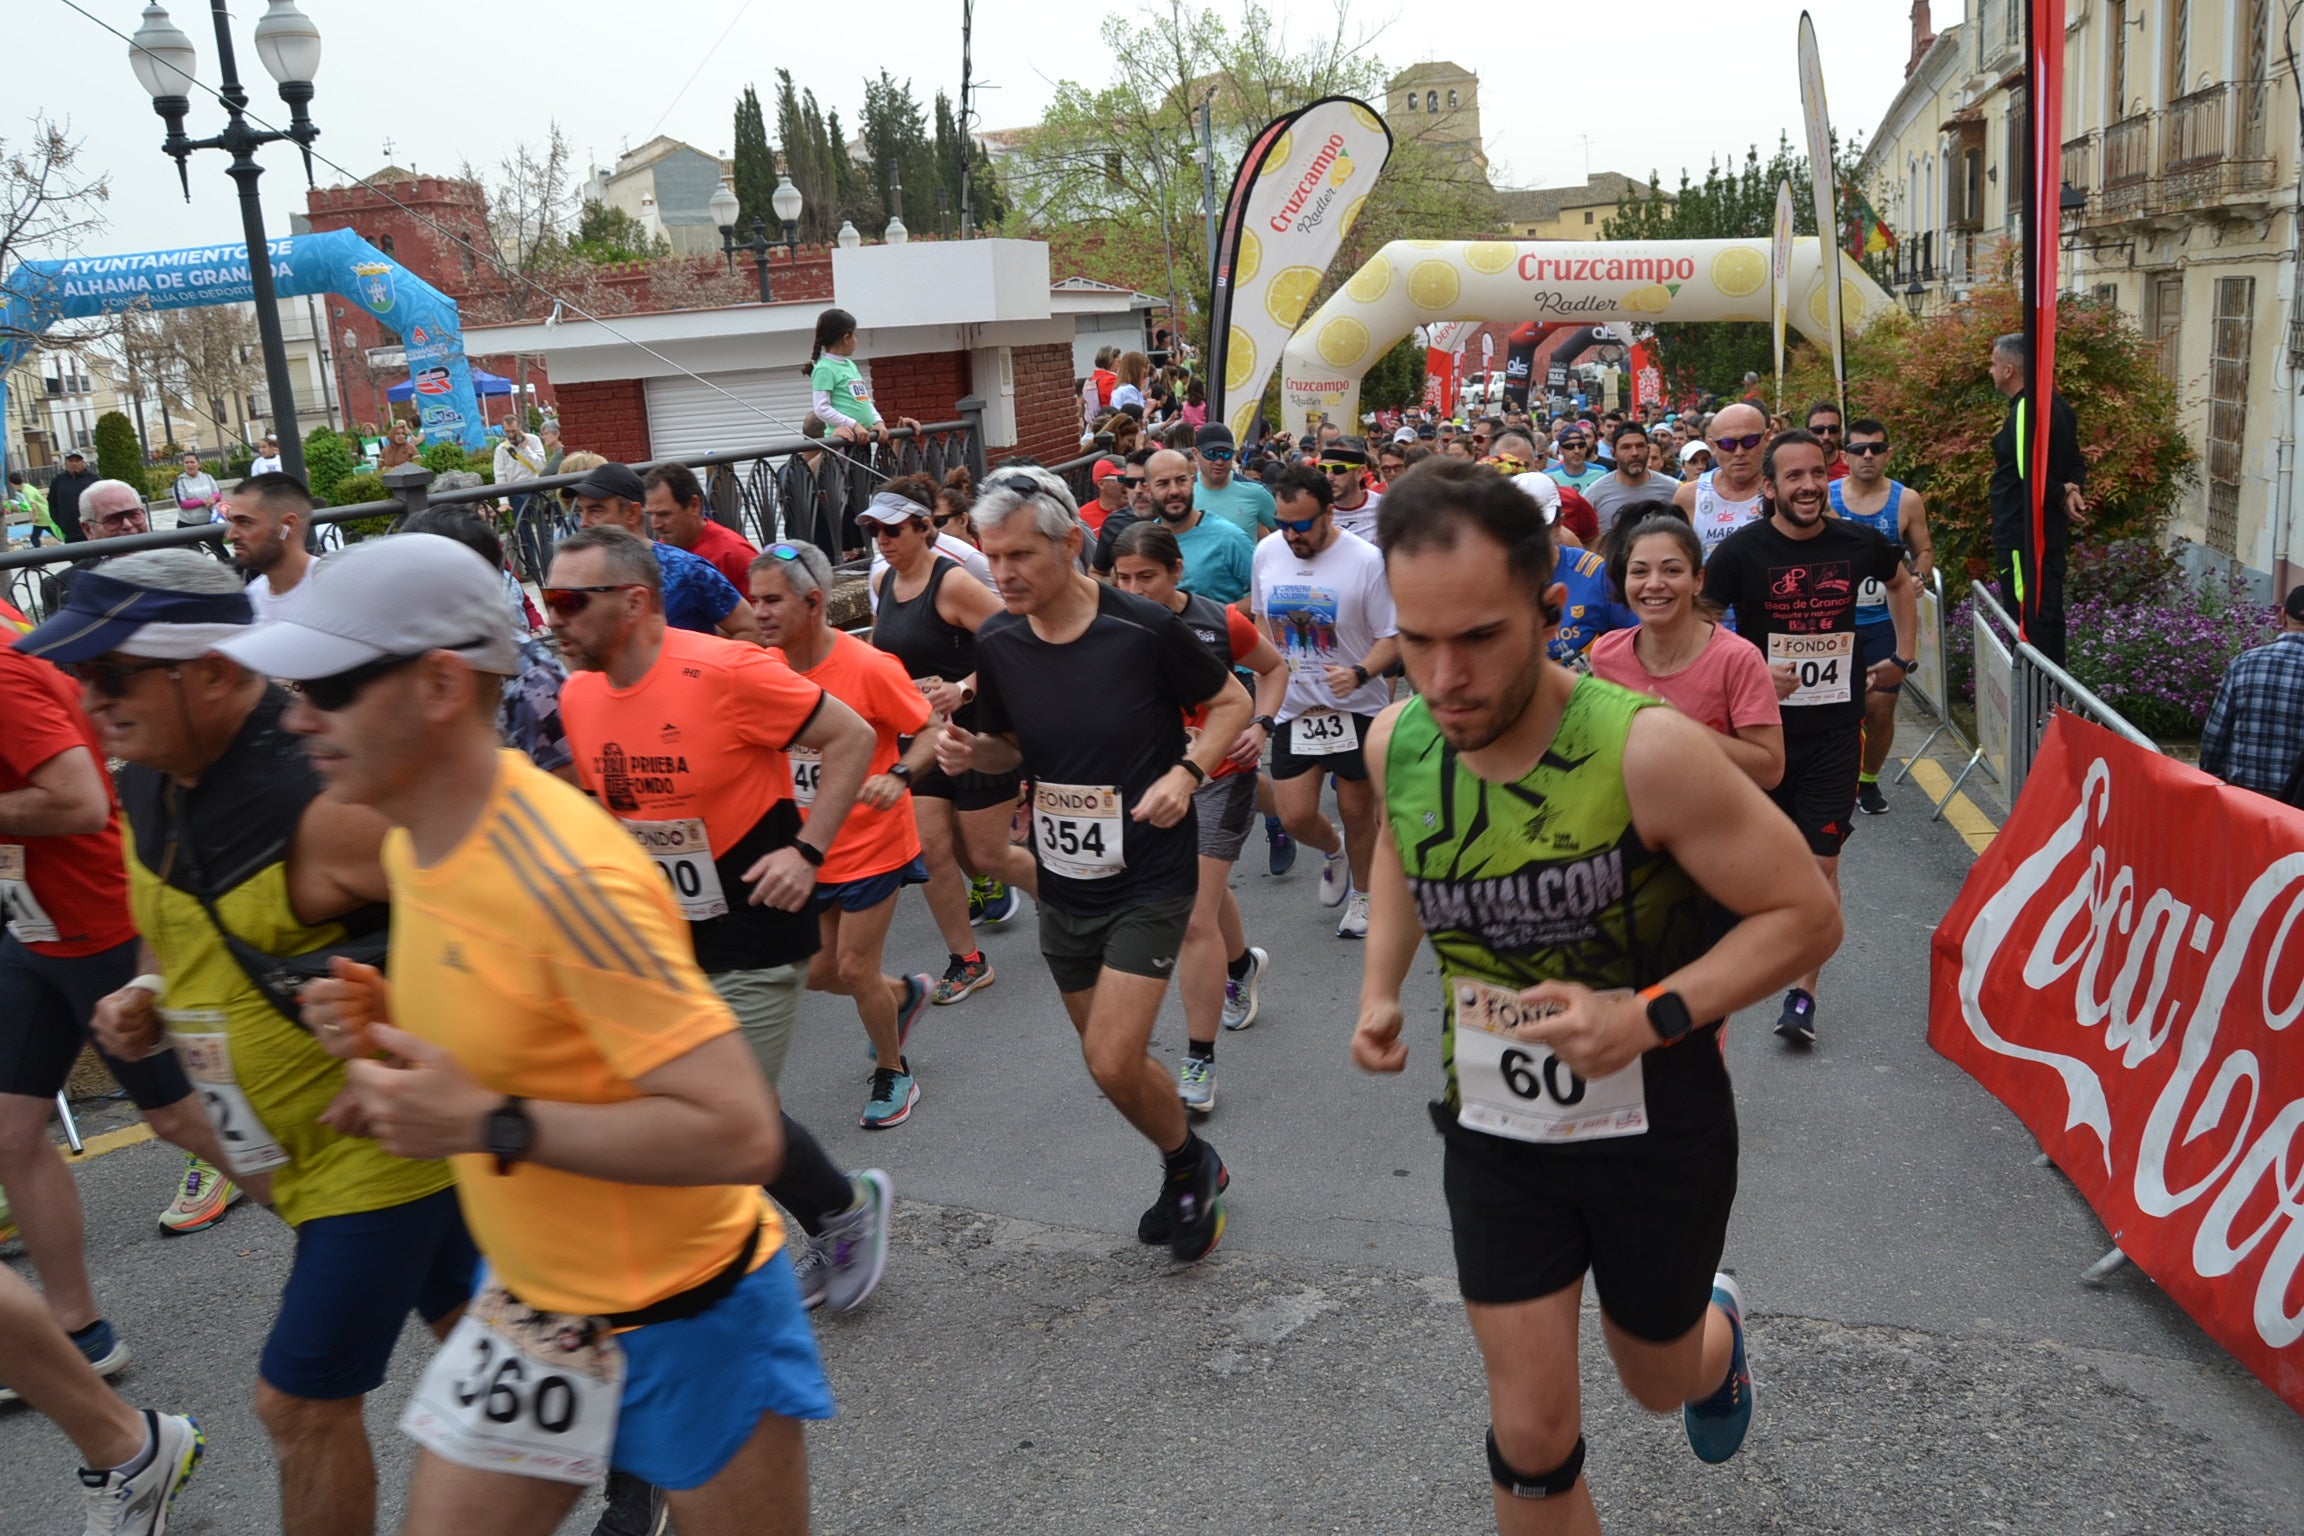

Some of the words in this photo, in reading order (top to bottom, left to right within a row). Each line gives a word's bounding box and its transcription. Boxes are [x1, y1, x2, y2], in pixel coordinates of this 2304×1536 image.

[1270, 133, 1345, 233] Cruzcampo
[1297, 188, 1336, 233] Radler
[61, 245, 250, 275] AYUNTAMIENTO
[266, 240, 294, 256] DE
[1518, 252, 1695, 285] Cruzcampo
[64, 275, 152, 298] ALHAMA
[155, 270, 186, 290] DE
[179, 289, 197, 301] DE
[199, 285, 255, 299] DEPORTE
[1534, 291, 1619, 315] Radler
[1286, 376, 1349, 392] Cruzcampo
[1290, 394, 1321, 407] Radler
[1793, 600, 1808, 609] de
[1786, 639, 1837, 652] FONDO
[1302, 714, 1344, 739] 343
[630, 756, 690, 774] PRUEBA
[625, 777, 675, 795] FONDO
[1038, 790, 1099, 810] FONDO
[631, 830, 685, 847] ONDO
[1041, 815, 1106, 858] 354
[1500, 1048, 1588, 1106] 60
